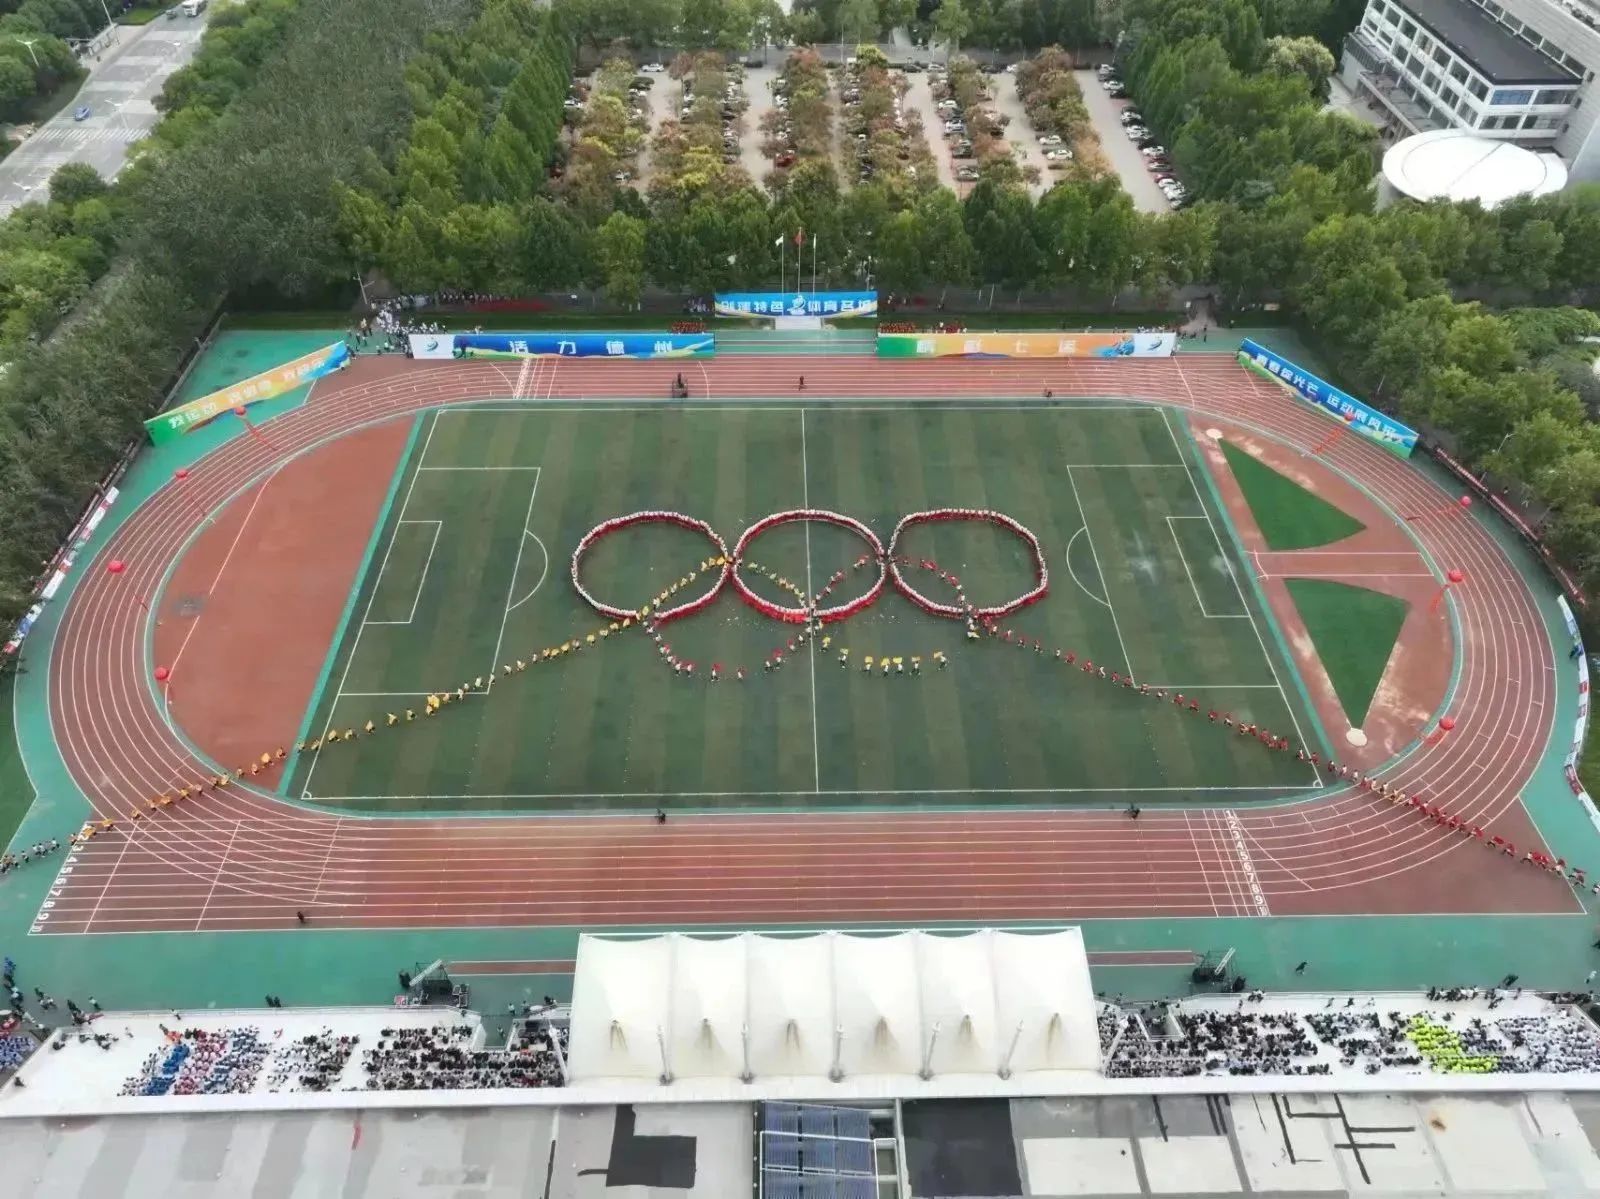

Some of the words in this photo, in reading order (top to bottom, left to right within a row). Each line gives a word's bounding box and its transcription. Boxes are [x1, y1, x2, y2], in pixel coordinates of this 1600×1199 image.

[509, 340, 673, 355] 活力德州
[1225, 810, 1234, 818] 1
[1229, 821, 1237, 829] 2
[1232, 831, 1241, 839] 3
[1236, 841, 1244, 849] 4
[1240, 851, 1248, 860] 5
[1244, 862, 1252, 871] 6
[1247, 873, 1255, 882] 7
[1251, 884, 1259, 893] 8
[1255, 895, 1263, 904] 9
